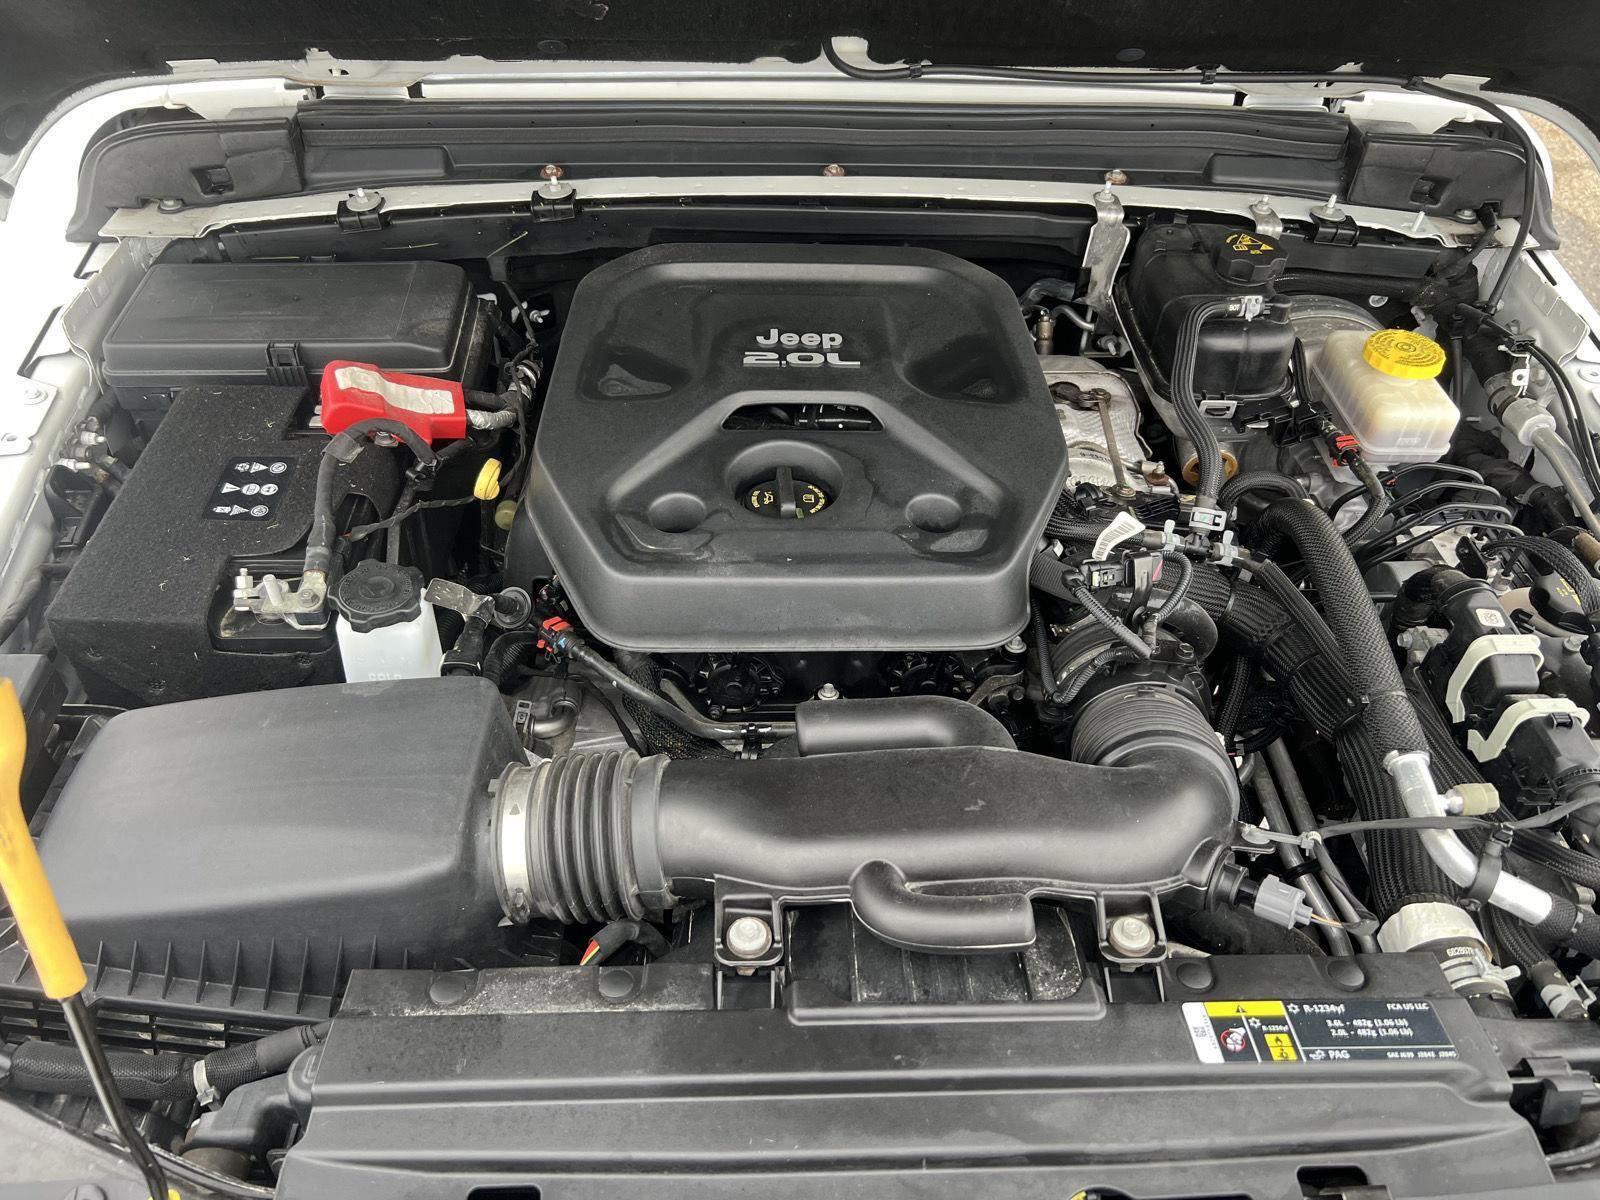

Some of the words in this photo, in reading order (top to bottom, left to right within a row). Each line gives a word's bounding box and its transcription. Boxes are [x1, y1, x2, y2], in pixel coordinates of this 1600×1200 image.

[756, 328, 843, 351] Jeep
[743, 351, 861, 368] 2.0L
[1303, 1003, 1346, 1014] R-1234yf
[1386, 1003, 1403, 1011] FCA
[1330, 1028, 1349, 1036] 2.0L
[1328, 1050, 1350, 1060] PAG
